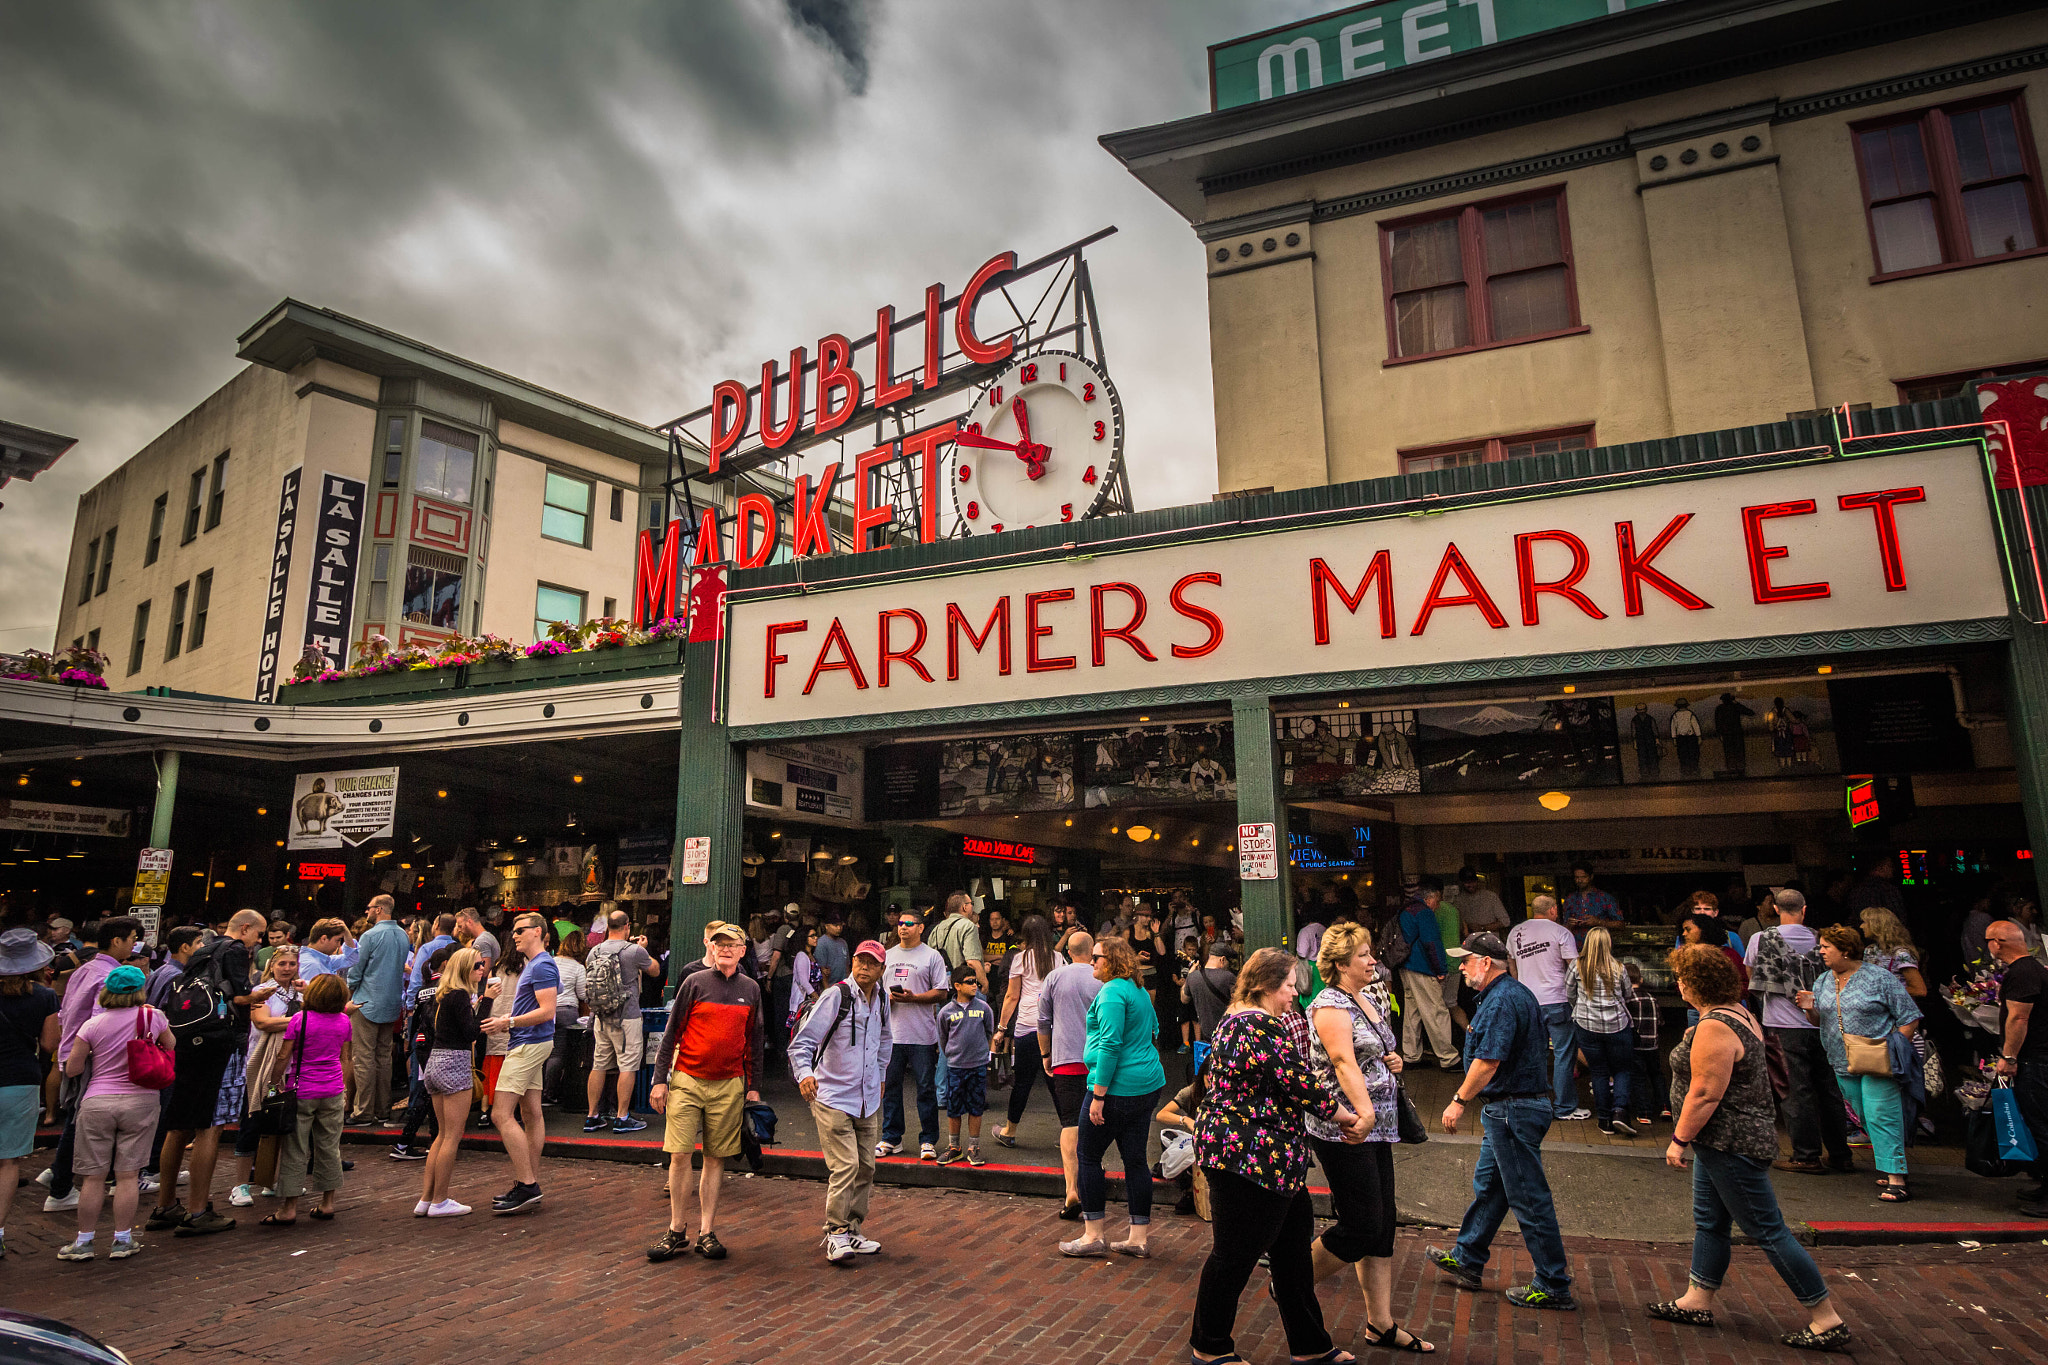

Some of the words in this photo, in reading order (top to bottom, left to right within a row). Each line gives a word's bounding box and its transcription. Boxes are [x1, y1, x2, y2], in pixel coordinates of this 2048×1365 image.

[708, 250, 1018, 474] PUBLIC
[1021, 363, 1038, 384] 12
[990, 385, 1002, 406] 11
[1083, 383, 1096, 402] 2
[1093, 421, 1105, 441] 3
[959, 465, 971, 483] 9
[1082, 465, 1098, 485] 4
[281, 478, 297, 515] LA
[327, 479, 356, 521] LA
[967, 501, 979, 519] 8
[1061, 503, 1073, 523] 5
[634, 420, 958, 630] MARKET
[269, 519, 292, 619] SALLE
[314, 528, 351, 626] SALLE
[765, 571, 1224, 699] FARMERS
[1309, 486, 1926, 646] MARKET
[335, 777, 358, 792] YOUR
[358, 774, 395, 790] CHANGE
[342, 791, 372, 799] CHANGES
[1241, 826, 1256, 837] NO
[688, 839, 697, 848] NO
[963, 836, 993, 854] SOUND
[994, 841, 1014, 856] VIEW
[1015, 843, 1035, 858] CAFE
[1243, 838, 1272, 850] STOPS
[1640, 847, 1729, 863] BAKERY
[1516, 941, 1551, 957] COSSACKS
[950, 1011, 964, 1022] OLD
[968, 1009, 985, 1018] NAVY
[2004, 1102, 2016, 1138] Columbia
